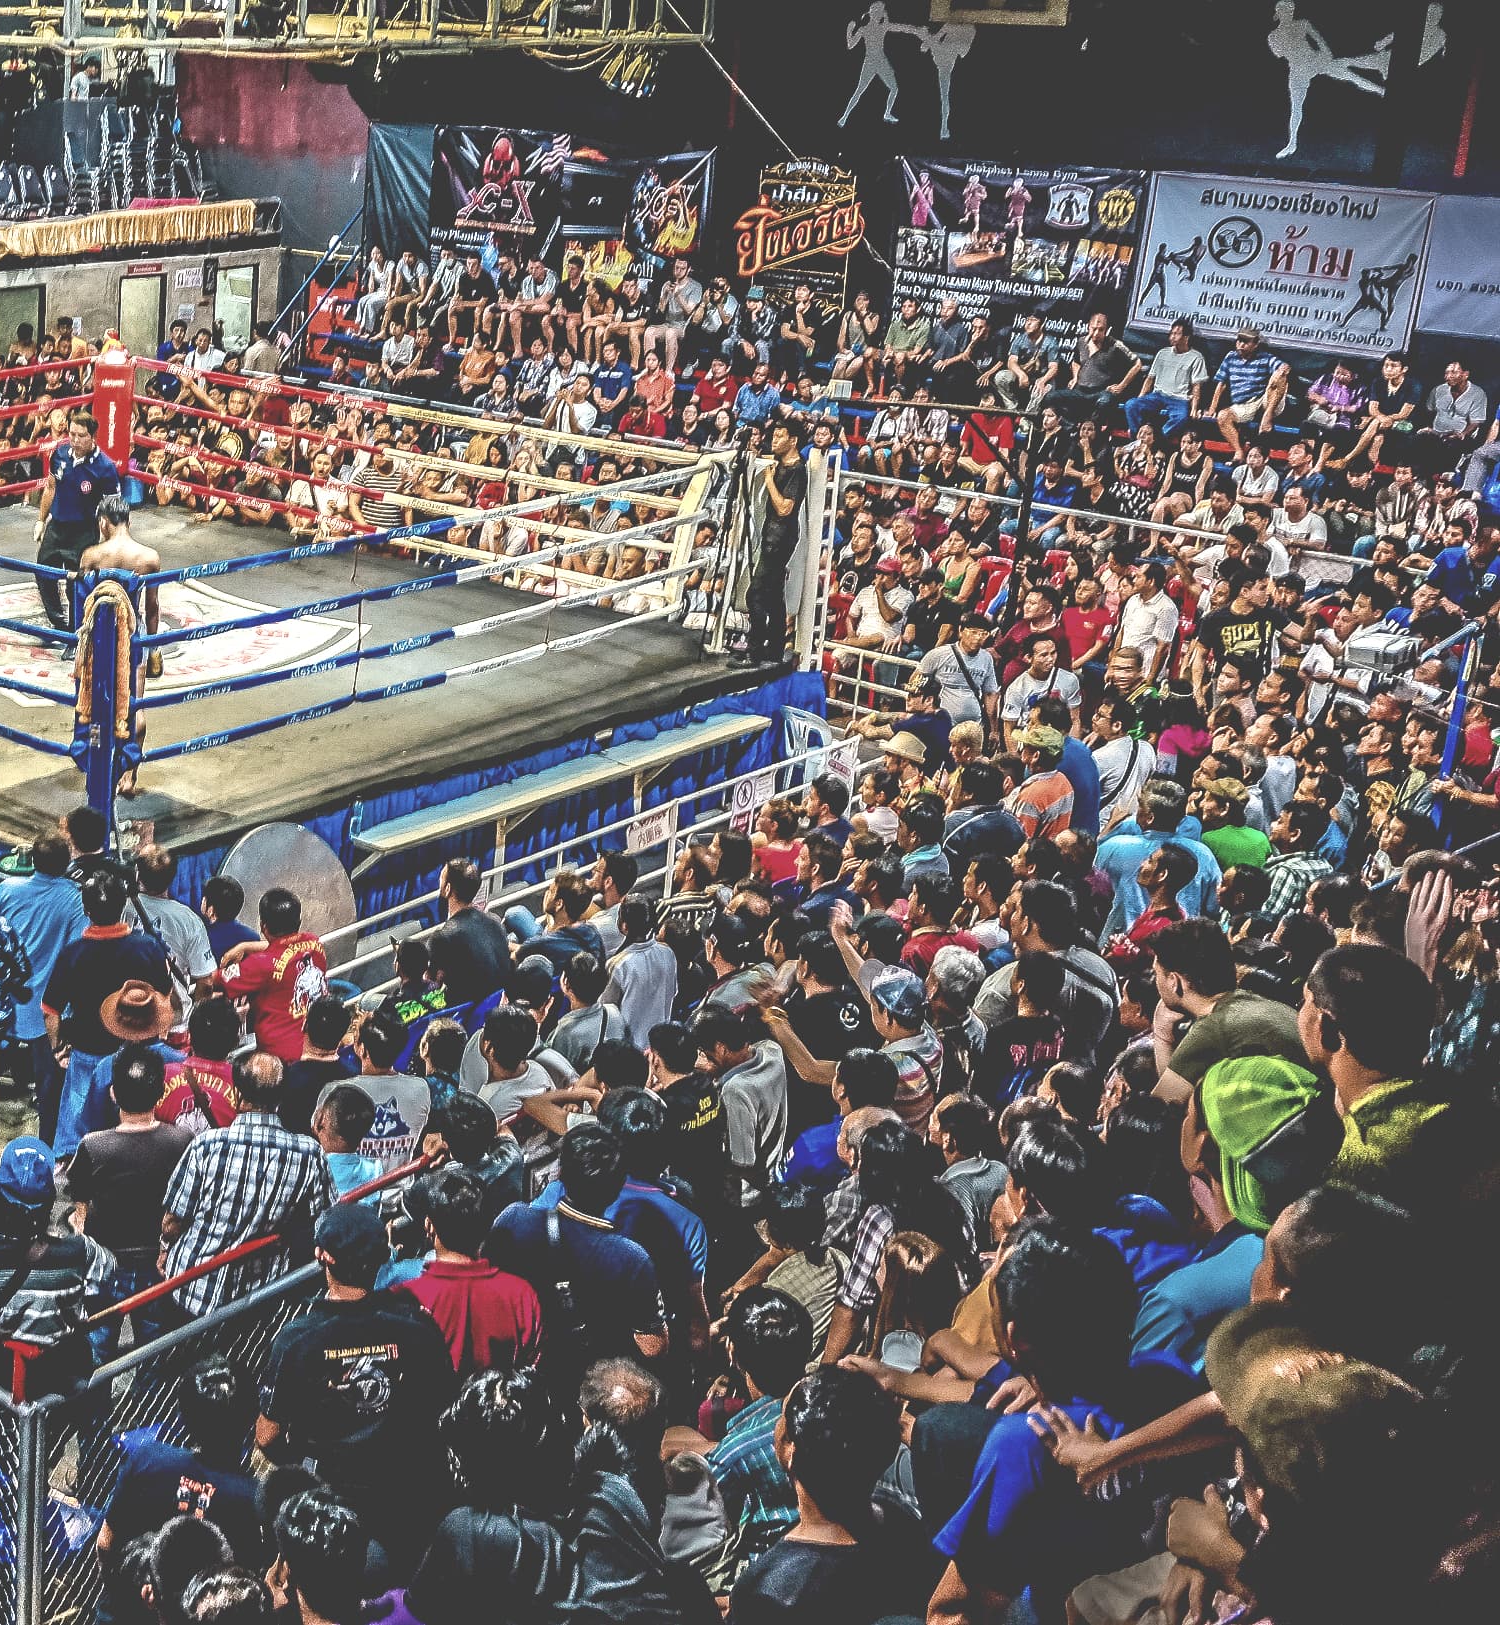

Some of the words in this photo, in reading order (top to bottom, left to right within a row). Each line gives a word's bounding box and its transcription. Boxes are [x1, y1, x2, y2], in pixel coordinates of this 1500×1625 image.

[1200, 188, 1380, 220] สนามมวยเชียงใหม่
[1267, 224, 1355, 278] ห้าม
